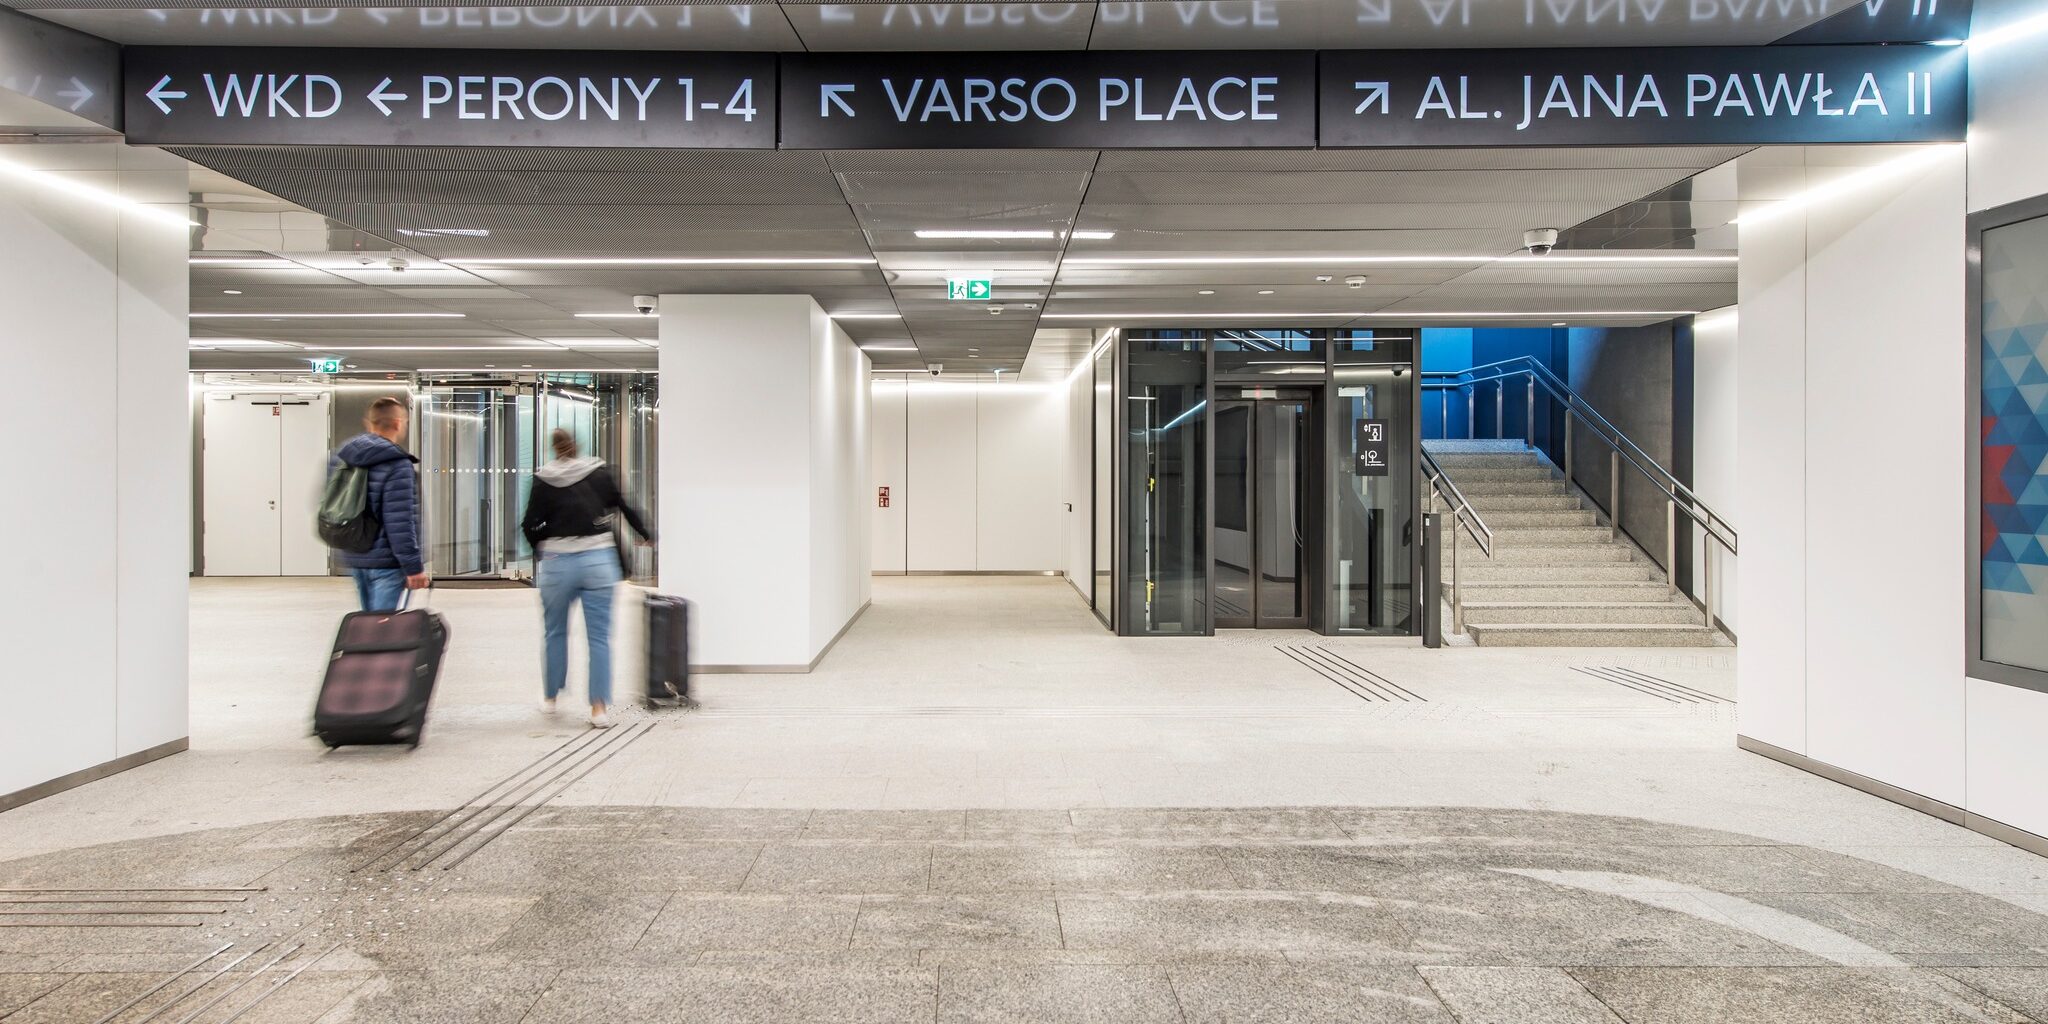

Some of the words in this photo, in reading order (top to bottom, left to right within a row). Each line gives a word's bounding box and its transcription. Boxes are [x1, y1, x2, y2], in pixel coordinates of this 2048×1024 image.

[203, 73, 343, 118] WKD
[422, 75, 661, 122] PERONY
[678, 78, 757, 123] 1-4
[882, 78, 1077, 122] VARSO
[1099, 77, 1279, 121] PLACE
[1414, 76, 1502, 119] AL.
[1516, 74, 1669, 131] JANA
[1687, 73, 1889, 117] PAWŁA
[1907, 72, 1933, 116] II
